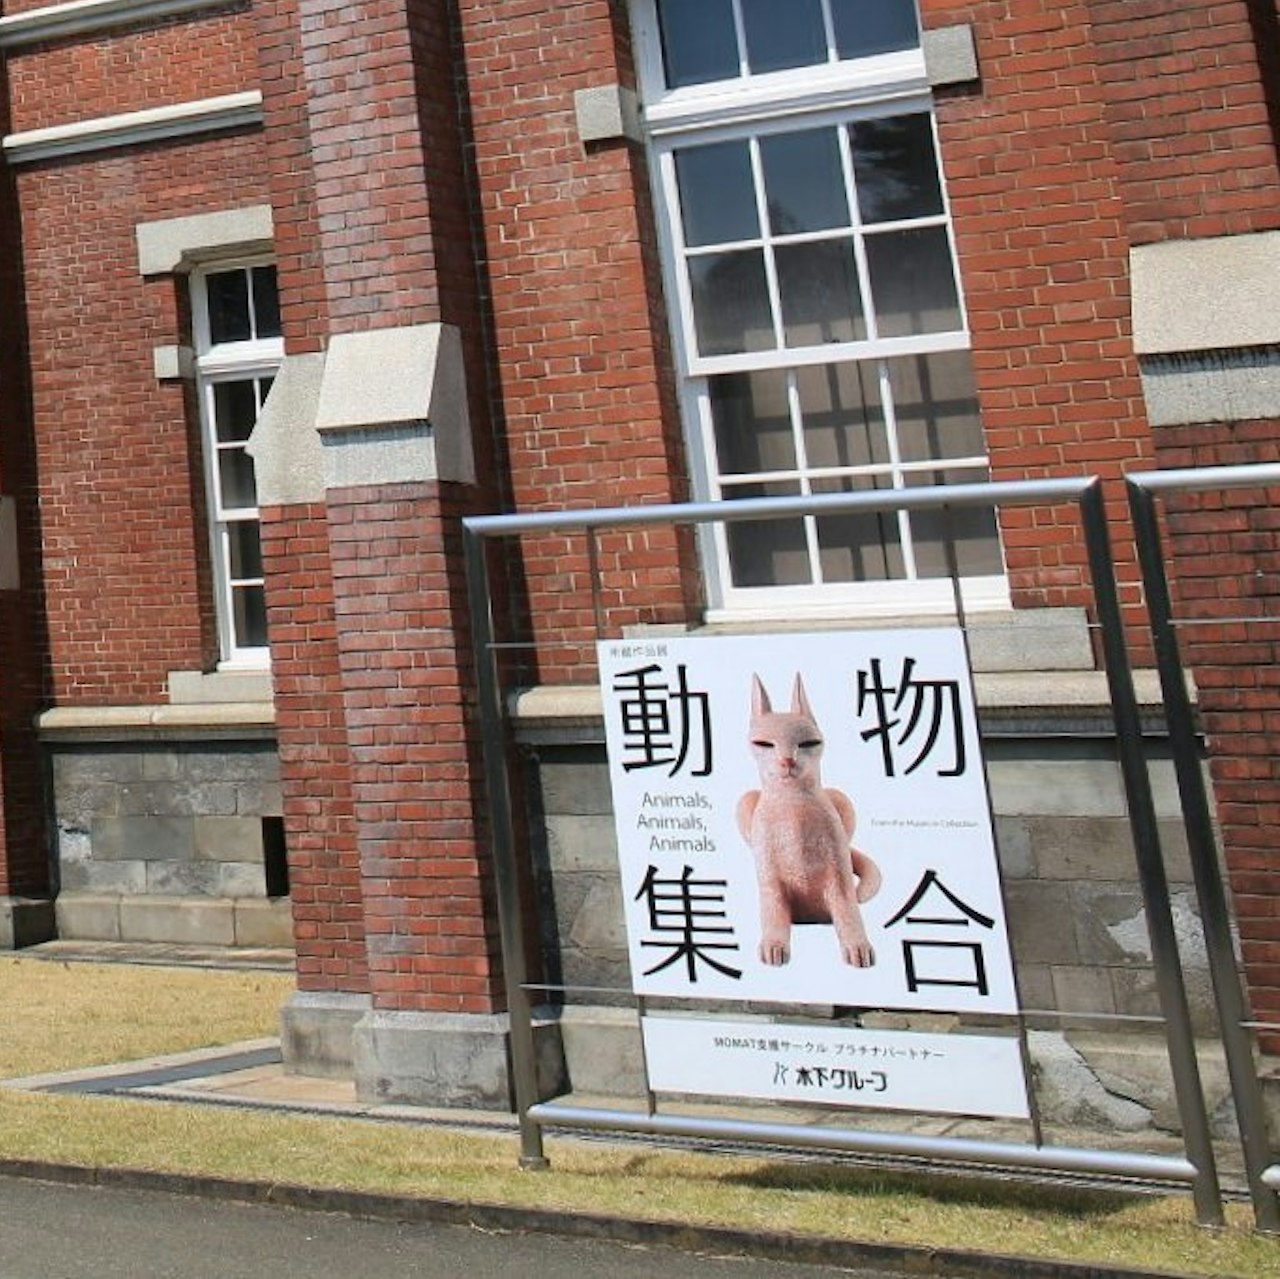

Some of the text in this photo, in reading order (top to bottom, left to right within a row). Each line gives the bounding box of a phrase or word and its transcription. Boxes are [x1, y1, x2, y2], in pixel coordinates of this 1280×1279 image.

[612, 656, 967, 778] 動 物
[641, 791, 713, 811] Animals,
[636, 813, 707, 833] Animals,
[649, 835, 717, 852] Animals
[634, 864, 996, 996] 集 合
